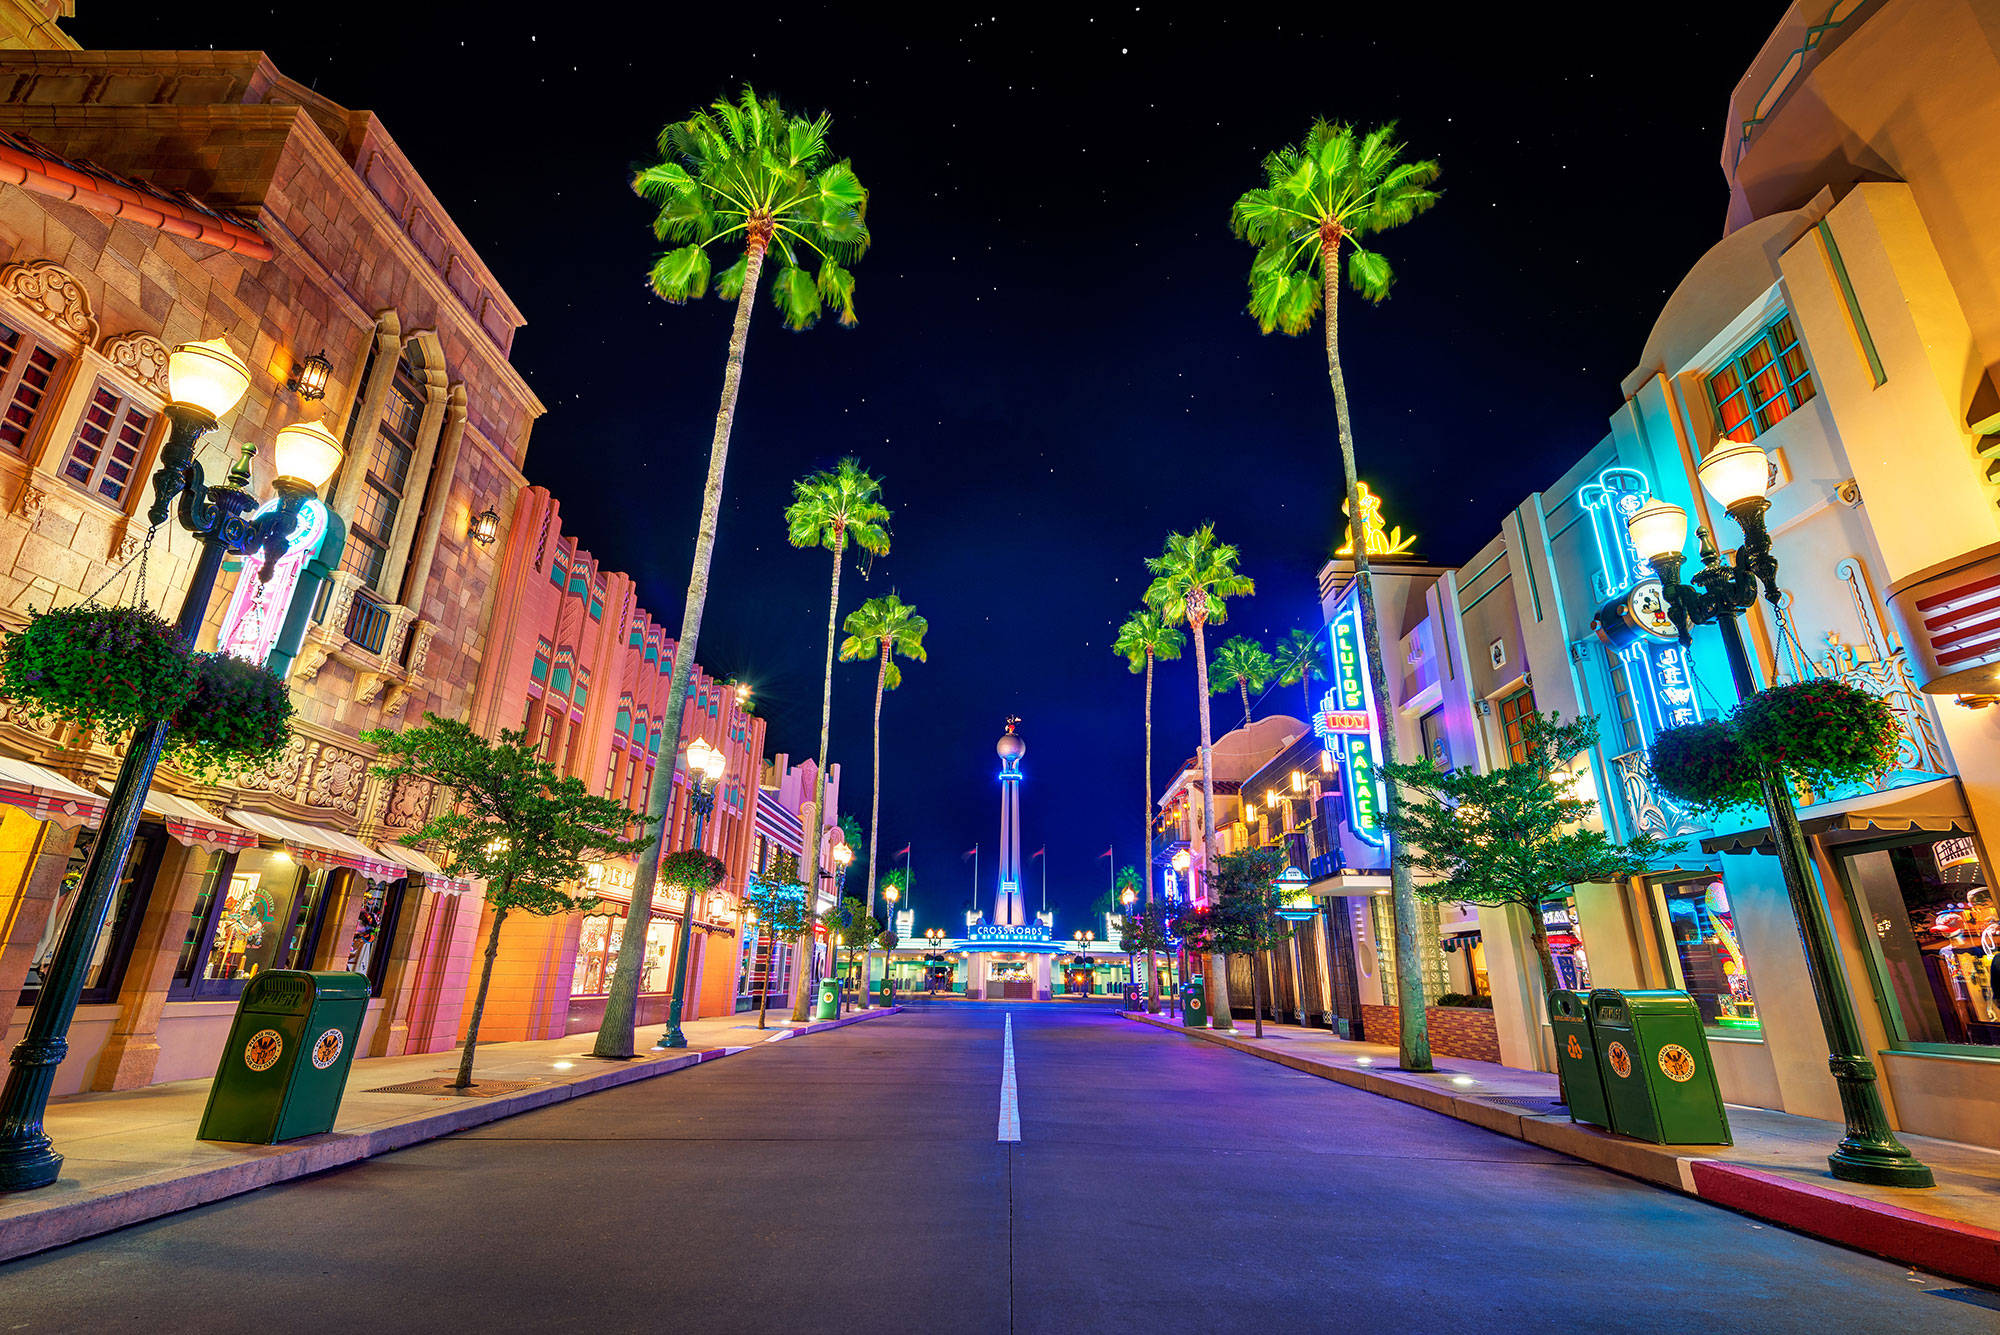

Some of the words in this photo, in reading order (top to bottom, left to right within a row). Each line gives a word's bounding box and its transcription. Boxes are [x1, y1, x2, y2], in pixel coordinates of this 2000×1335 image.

[1337, 623, 1362, 707] PLUTO'S
[1328, 714, 1366, 729] TOY
[1351, 740, 1374, 829] PALACE
[977, 926, 1043, 935] CROSSROADS
